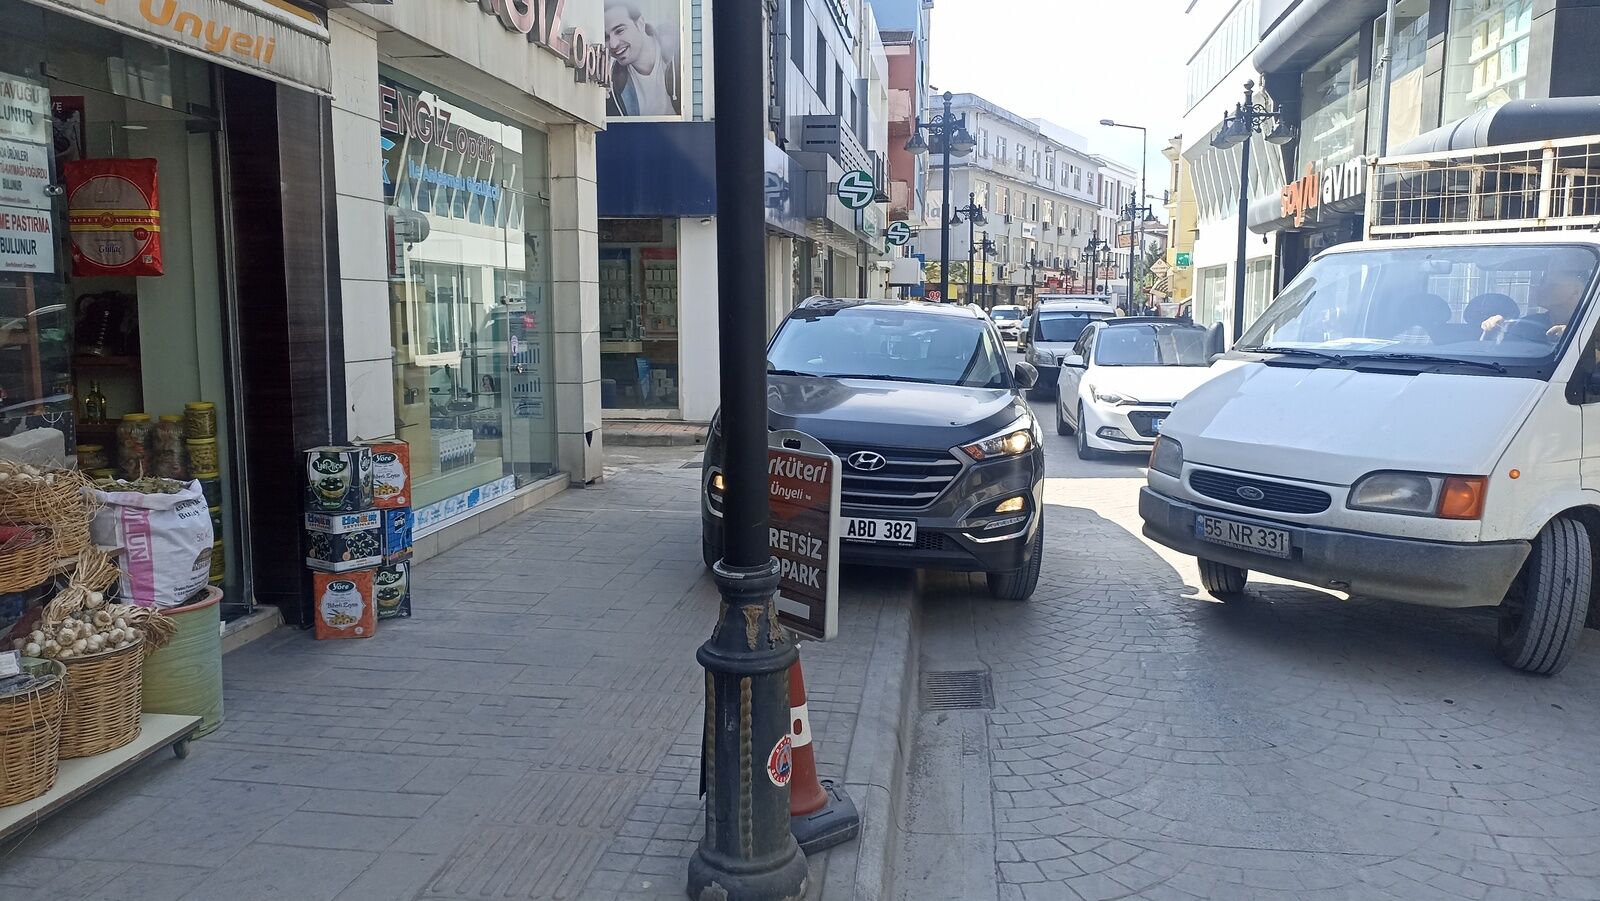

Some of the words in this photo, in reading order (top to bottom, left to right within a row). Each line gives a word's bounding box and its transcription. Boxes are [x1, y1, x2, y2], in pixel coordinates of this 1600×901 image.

[379, 83, 454, 152] ENGİZ
[455, 126, 496, 165] Optik
[1322, 155, 1362, 205] avm
[11, 214, 50, 234] PASTIRMA
[0, 236, 38, 255] BULUNUR
[768, 457, 828, 484] rküteri
[770, 481, 803, 500] Ünyeli
[847, 519, 877, 538] ABD
[883, 522, 912, 541] 382
[1205, 519, 1223, 537] 55
[1228, 522, 1253, 545] NR
[1257, 528, 1285, 552] 331
[769, 528, 823, 560] RETSİZ
